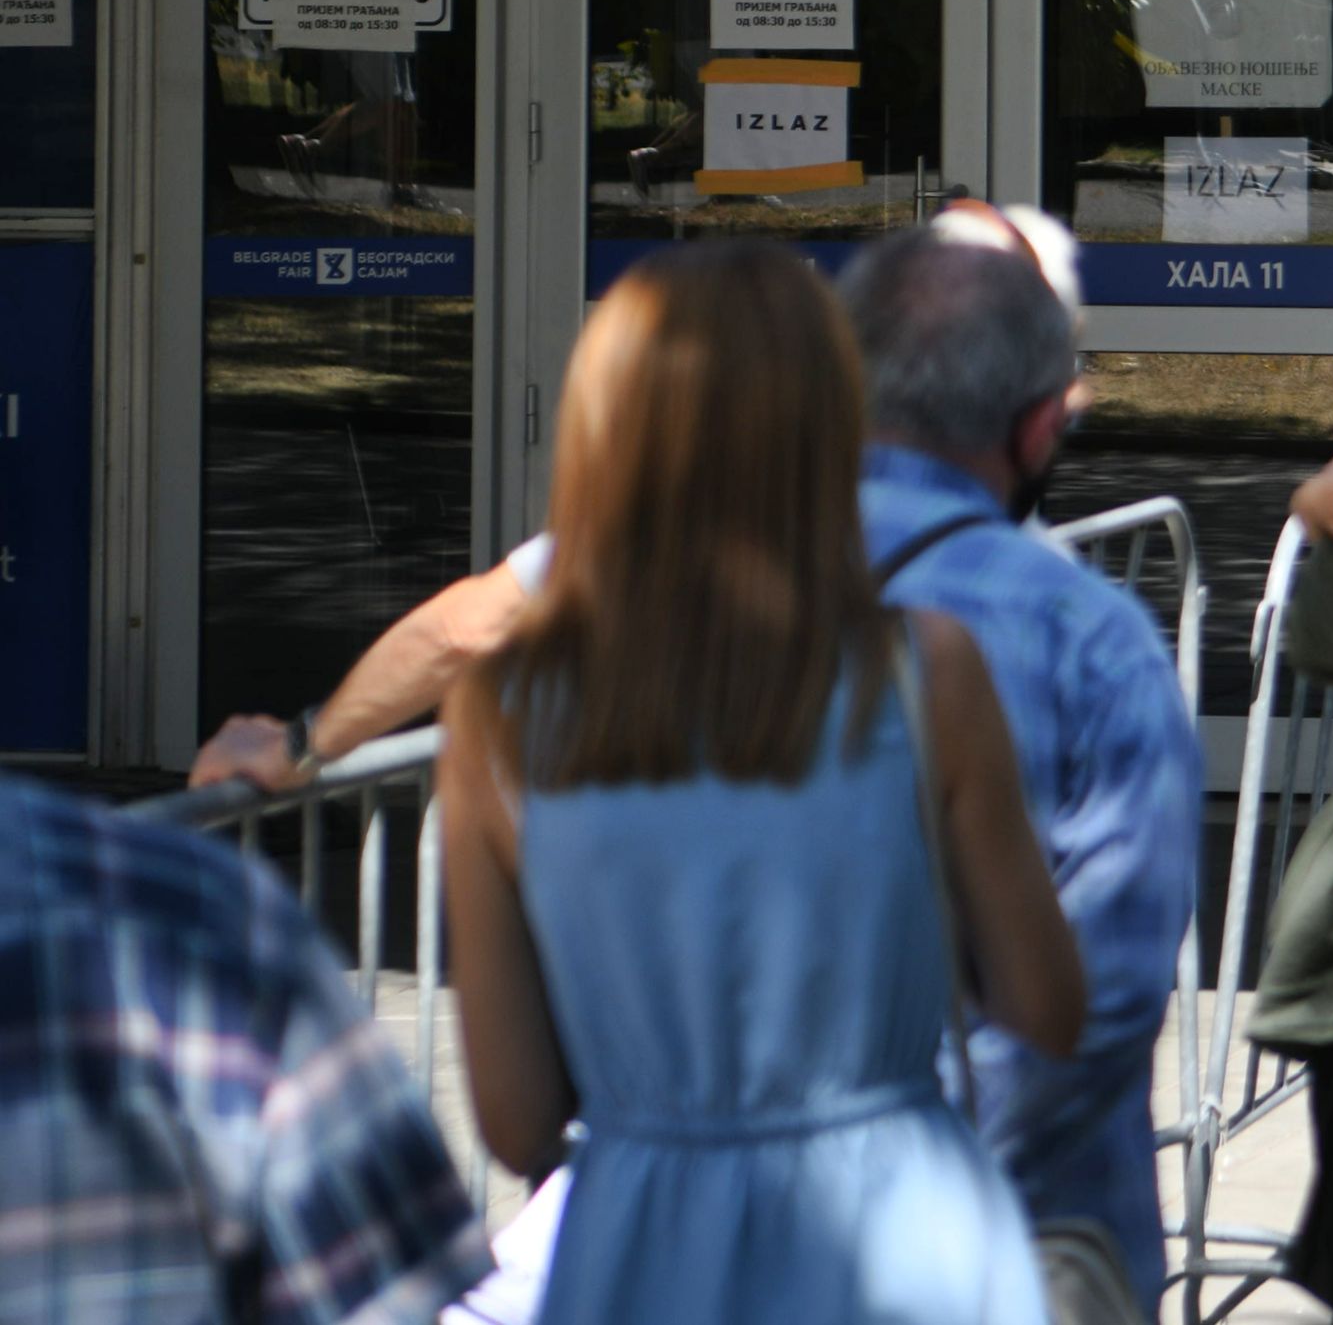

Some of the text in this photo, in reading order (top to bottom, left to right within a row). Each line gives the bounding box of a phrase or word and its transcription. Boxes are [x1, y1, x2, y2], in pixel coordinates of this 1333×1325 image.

[298, 5, 400, 16] ПРИЈЕМ ГРАЂАНА
[736, 2, 837, 12] ПРИЈЕМ ГРАЂАНА
[298, 20, 398, 31] од 08:30 до 15:30
[736, 16, 836, 27] од 08:30 до 15:30
[1144, 61, 1320, 76] ОБАВЕЗНО НОШЕЊЕ
[1200, 82, 1263, 96] МАСКЕ
[736, 113, 829, 131] IZLAZ
[1184, 165, 1286, 198] IZLAZ
[233, 251, 312, 264] BELGRADE
[357, 252, 455, 265] БЕОГРАДСКИ
[278, 267, 311, 278] FAIR
[357, 267, 408, 279] САЈАМ
[1167, 260, 1284, 289] ХАЛА 11
